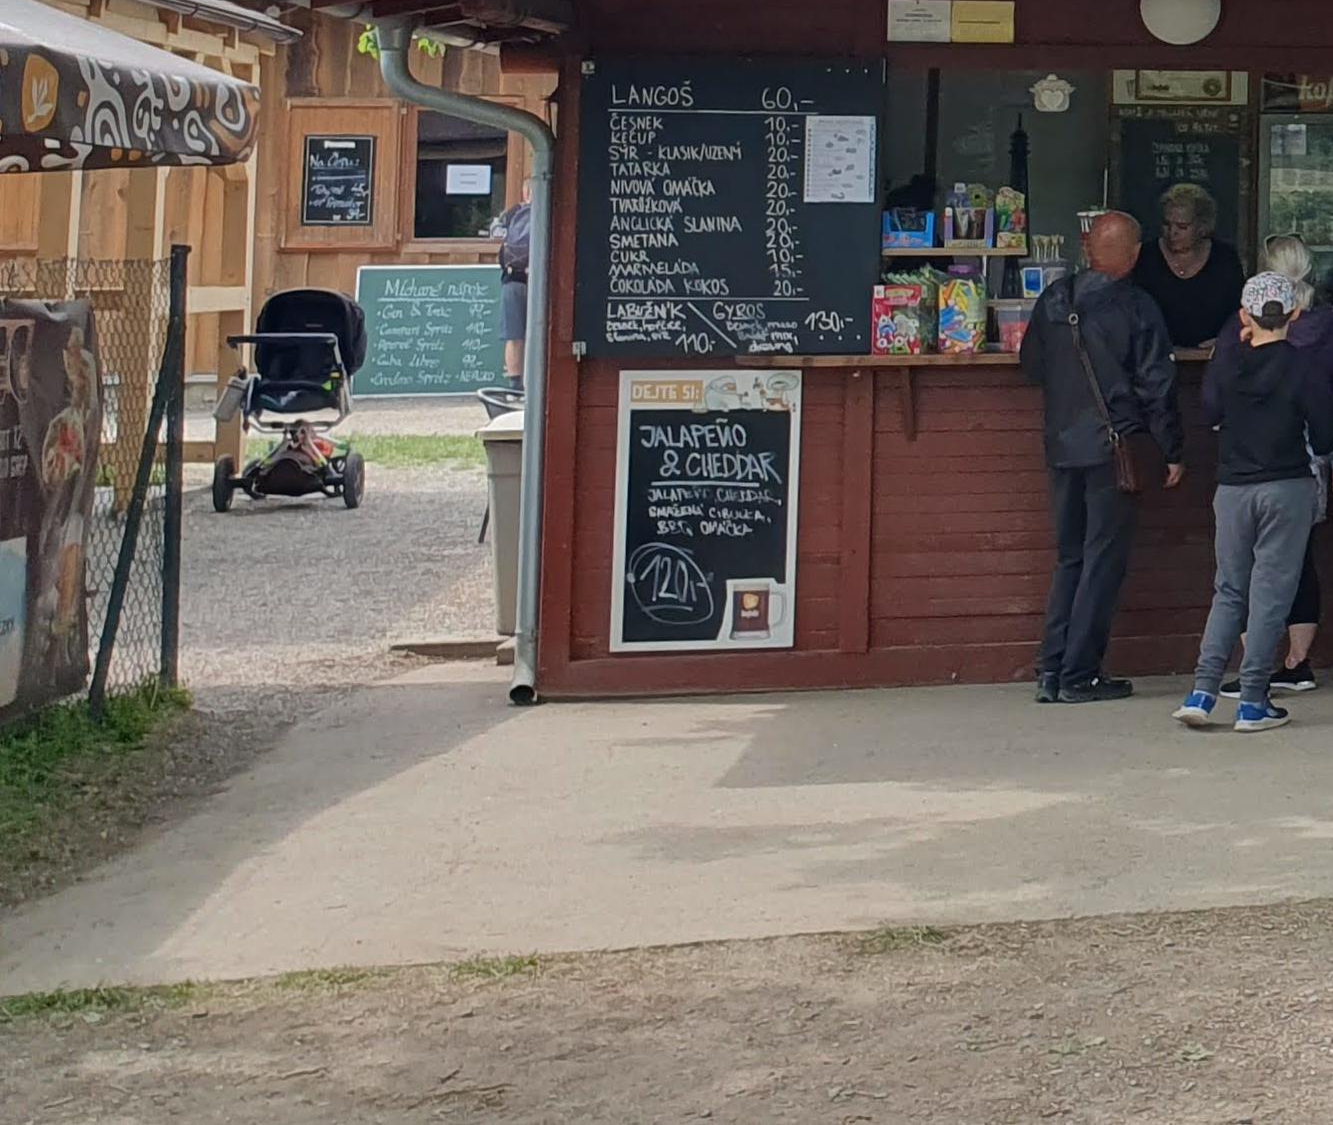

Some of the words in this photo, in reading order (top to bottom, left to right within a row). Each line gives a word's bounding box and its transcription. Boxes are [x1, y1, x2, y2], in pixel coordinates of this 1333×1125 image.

[611, 81, 694, 106] LANGOŠ
[761, 87, 814, 111] 60,-
[610, 113, 664, 130] ČESNEK
[610, 161, 671, 176] TATARKA
[610, 178, 656, 196] NIVOVÁ
[662, 176, 716, 197] OMÁČKA
[610, 213, 675, 232] ANGLICKÁ
[684, 216, 743, 233] SLANINA
[609, 233, 679, 249] SMETANA
[611, 250, 650, 263] CUKR
[610, 276, 676, 295] ČOKOLÁDA
[684, 278, 729, 296] KOKOS
[713, 301, 766, 320] GYROS
[632, 383, 677, 400] DEJTE
[682, 384, 700, 400] SI:
[639, 418, 747, 449] JALAPEÑO
[685, 452, 783, 484] CHEDDAR
